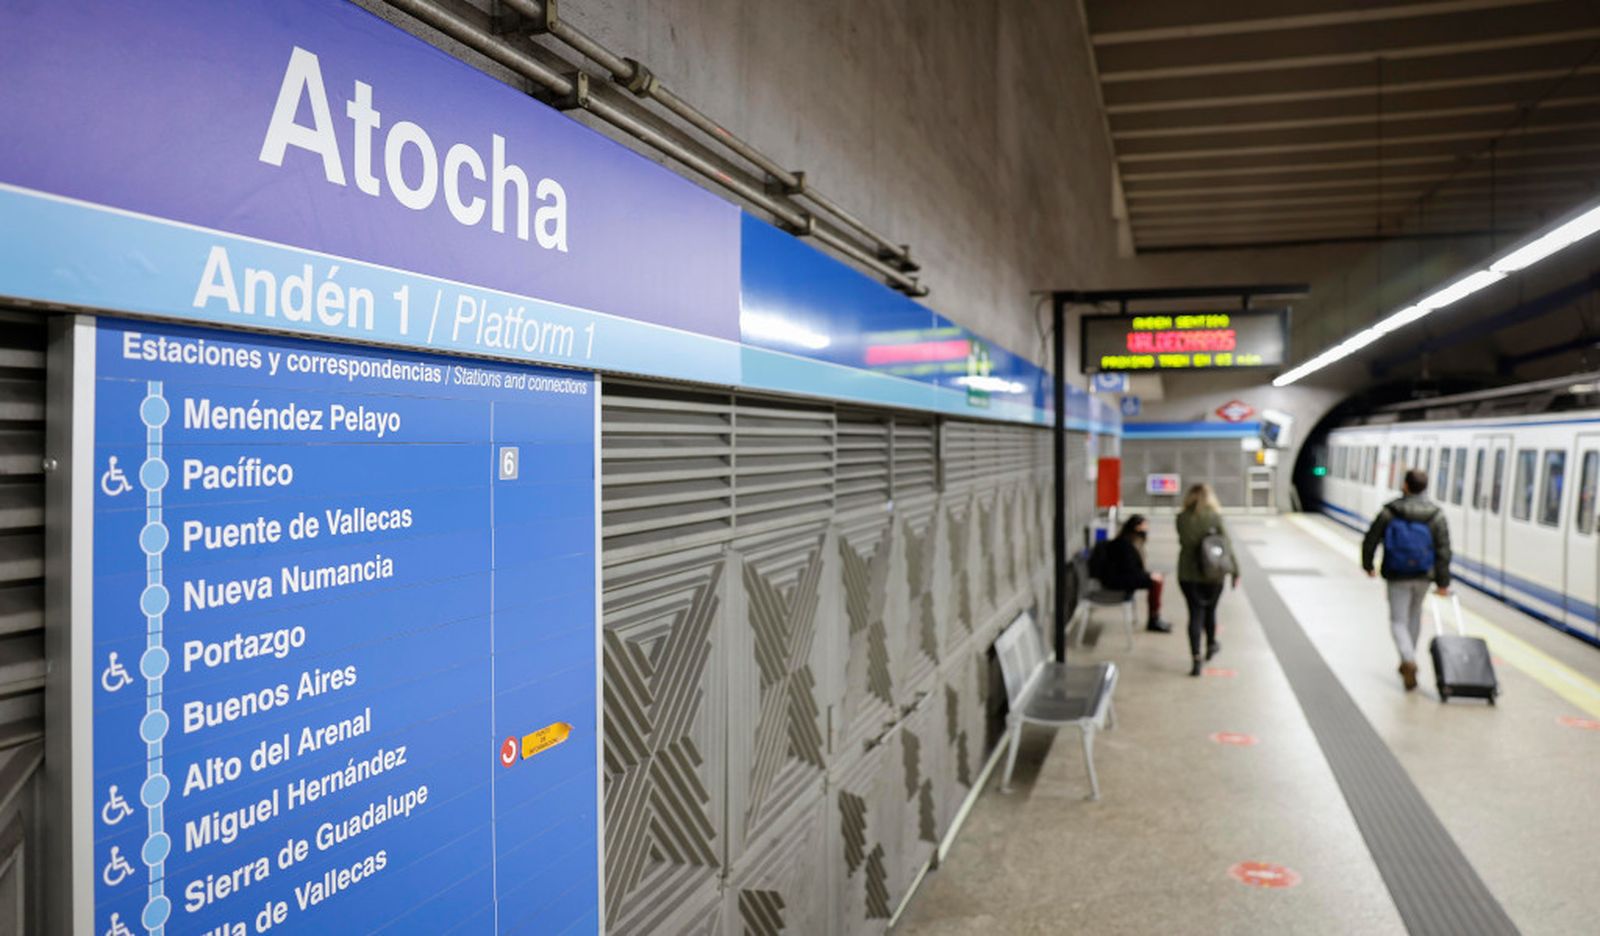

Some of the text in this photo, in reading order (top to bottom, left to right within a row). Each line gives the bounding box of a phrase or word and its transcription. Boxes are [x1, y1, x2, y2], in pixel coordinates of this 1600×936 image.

[258, 45, 569, 253] Atocha
[192, 245, 375, 331] Andén
[393, 285, 409, 335] 1
[452, 294, 575, 357] Platform
[584, 321, 596, 359] 1
[122, 331, 262, 369] Estaciones
[268, 351, 281, 376] y
[286, 353, 442, 384] correspondencias
[453, 365, 502, 389] Stations
[503, 373, 527, 390] and
[527, 376, 588, 395] connections
[184, 398, 401, 438] Menéndez Pelayo
[183, 457, 293, 490] Pacífico
[502, 450, 515, 476] 6
[183, 507, 413, 552] Puente de Vallecas
[184, 554, 394, 612] Nueva Numancia
[184, 626, 306, 672] Portazgo
[183, 665, 357, 734] Buenos Aires
[183, 707, 372, 796] Alto del Arenal
[185, 746, 407, 852] Miguel Hernández
[185, 785, 428, 913] Sierra de Guadalupe
[255, 850, 387, 933] de Vallecas
